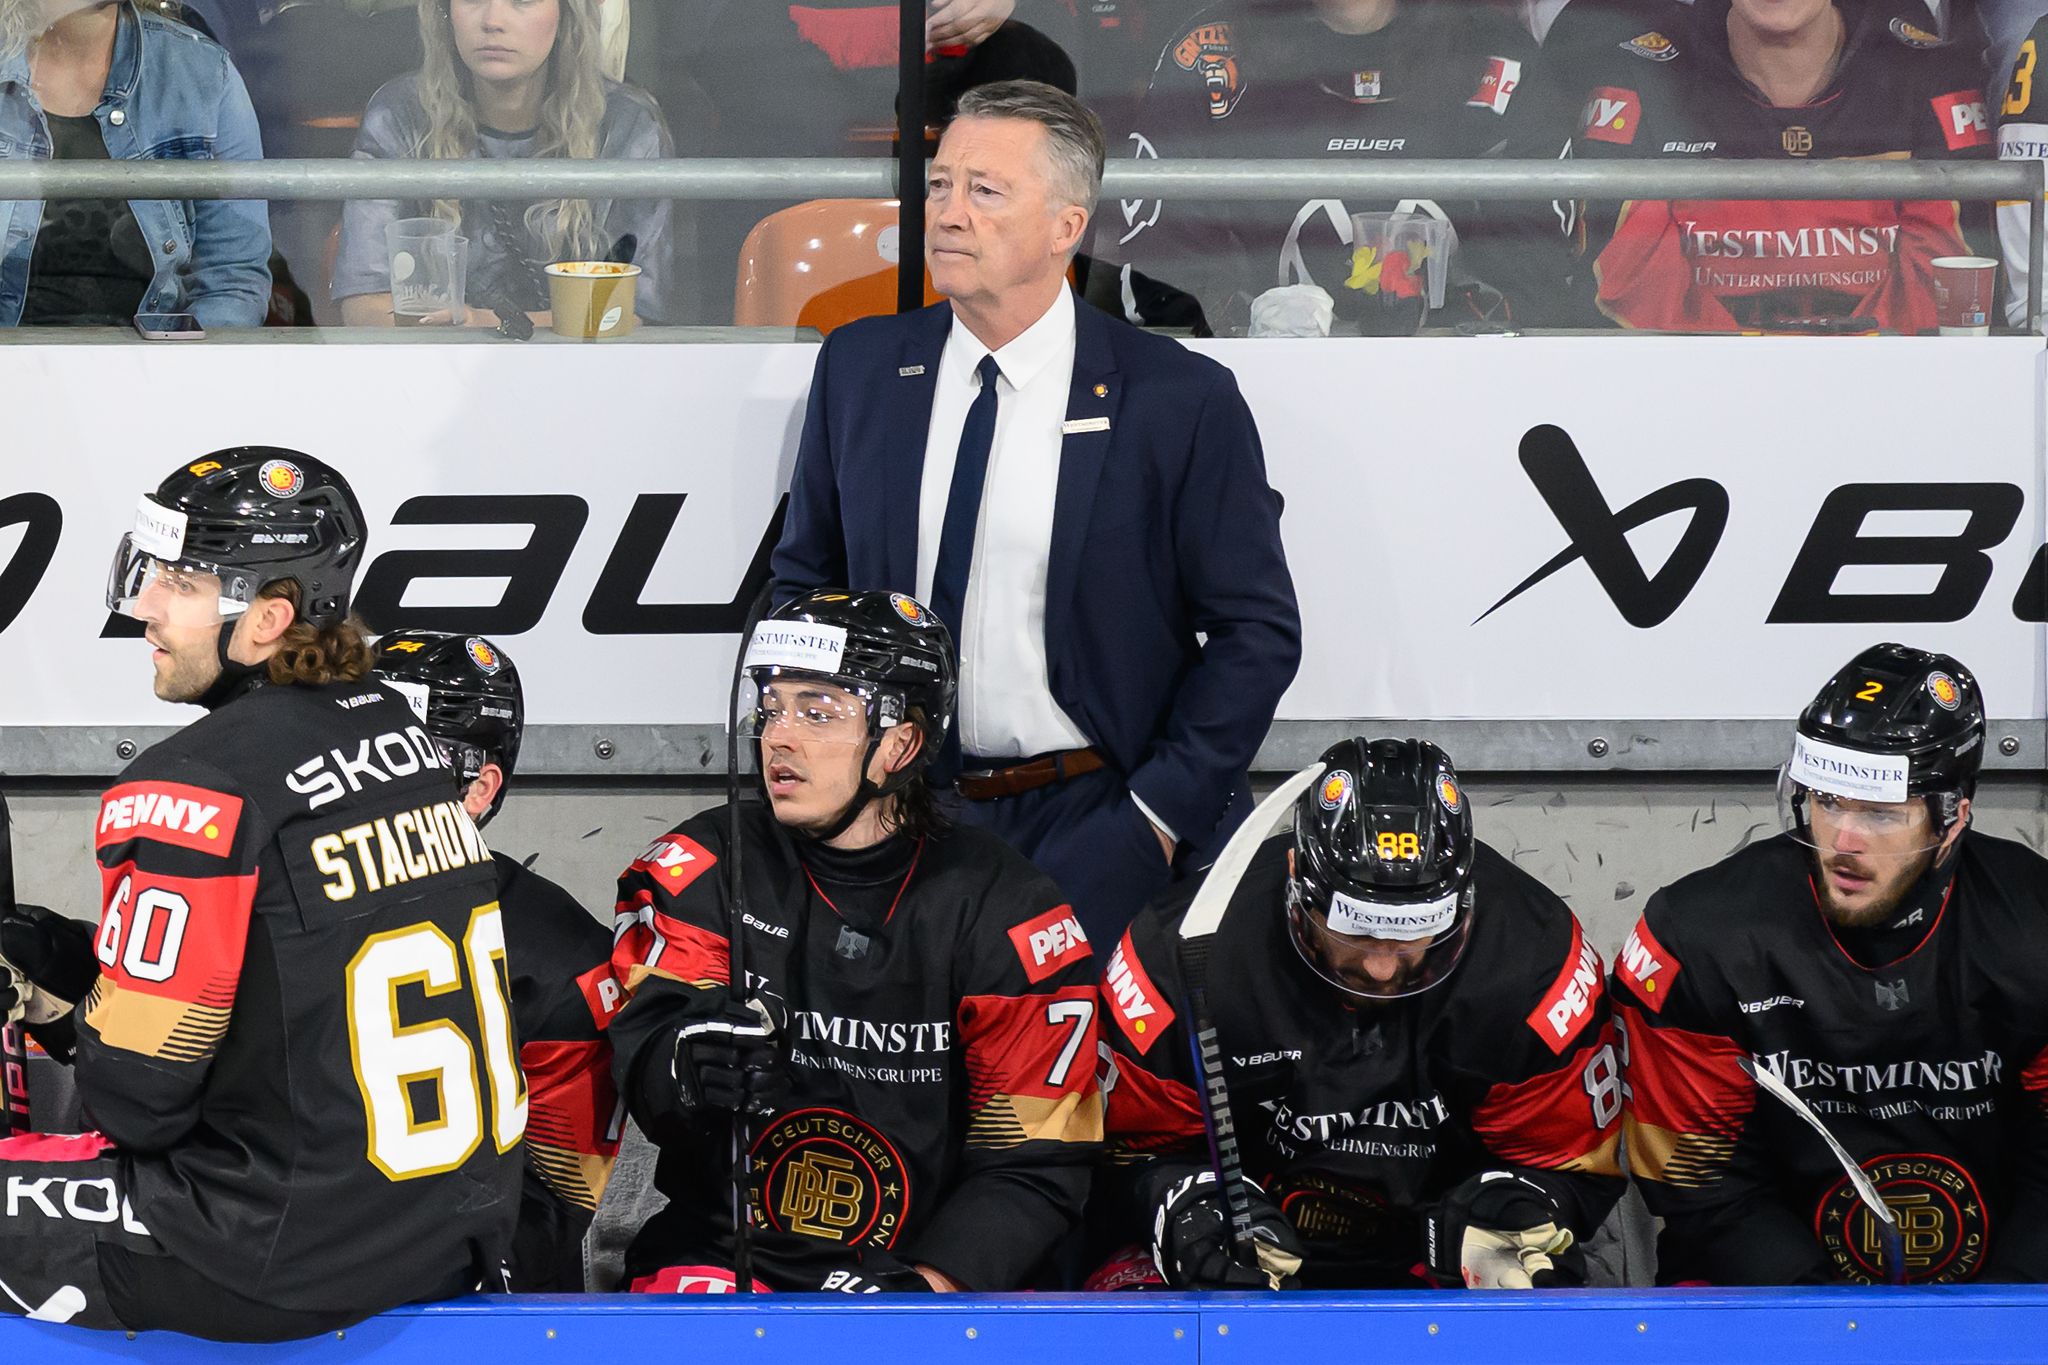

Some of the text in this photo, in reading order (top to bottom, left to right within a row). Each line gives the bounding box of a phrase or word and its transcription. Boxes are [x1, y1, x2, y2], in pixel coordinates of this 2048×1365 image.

[2001, 39, 2037, 115] 3
[1327, 138, 1406, 151] BAUER
[1856, 681, 1884, 702] 2
[285, 725, 451, 811] SKOD
[1376, 831, 1420, 861] 88
[97, 873, 192, 983] 60
[742, 912, 790, 939] BAUE
[345, 900, 529, 1182] 60
[794, 1010, 951, 1054] TMINSTE
[1046, 1000, 1094, 1087] 7
[771, 1117, 892, 1173] DEUTSCHER
